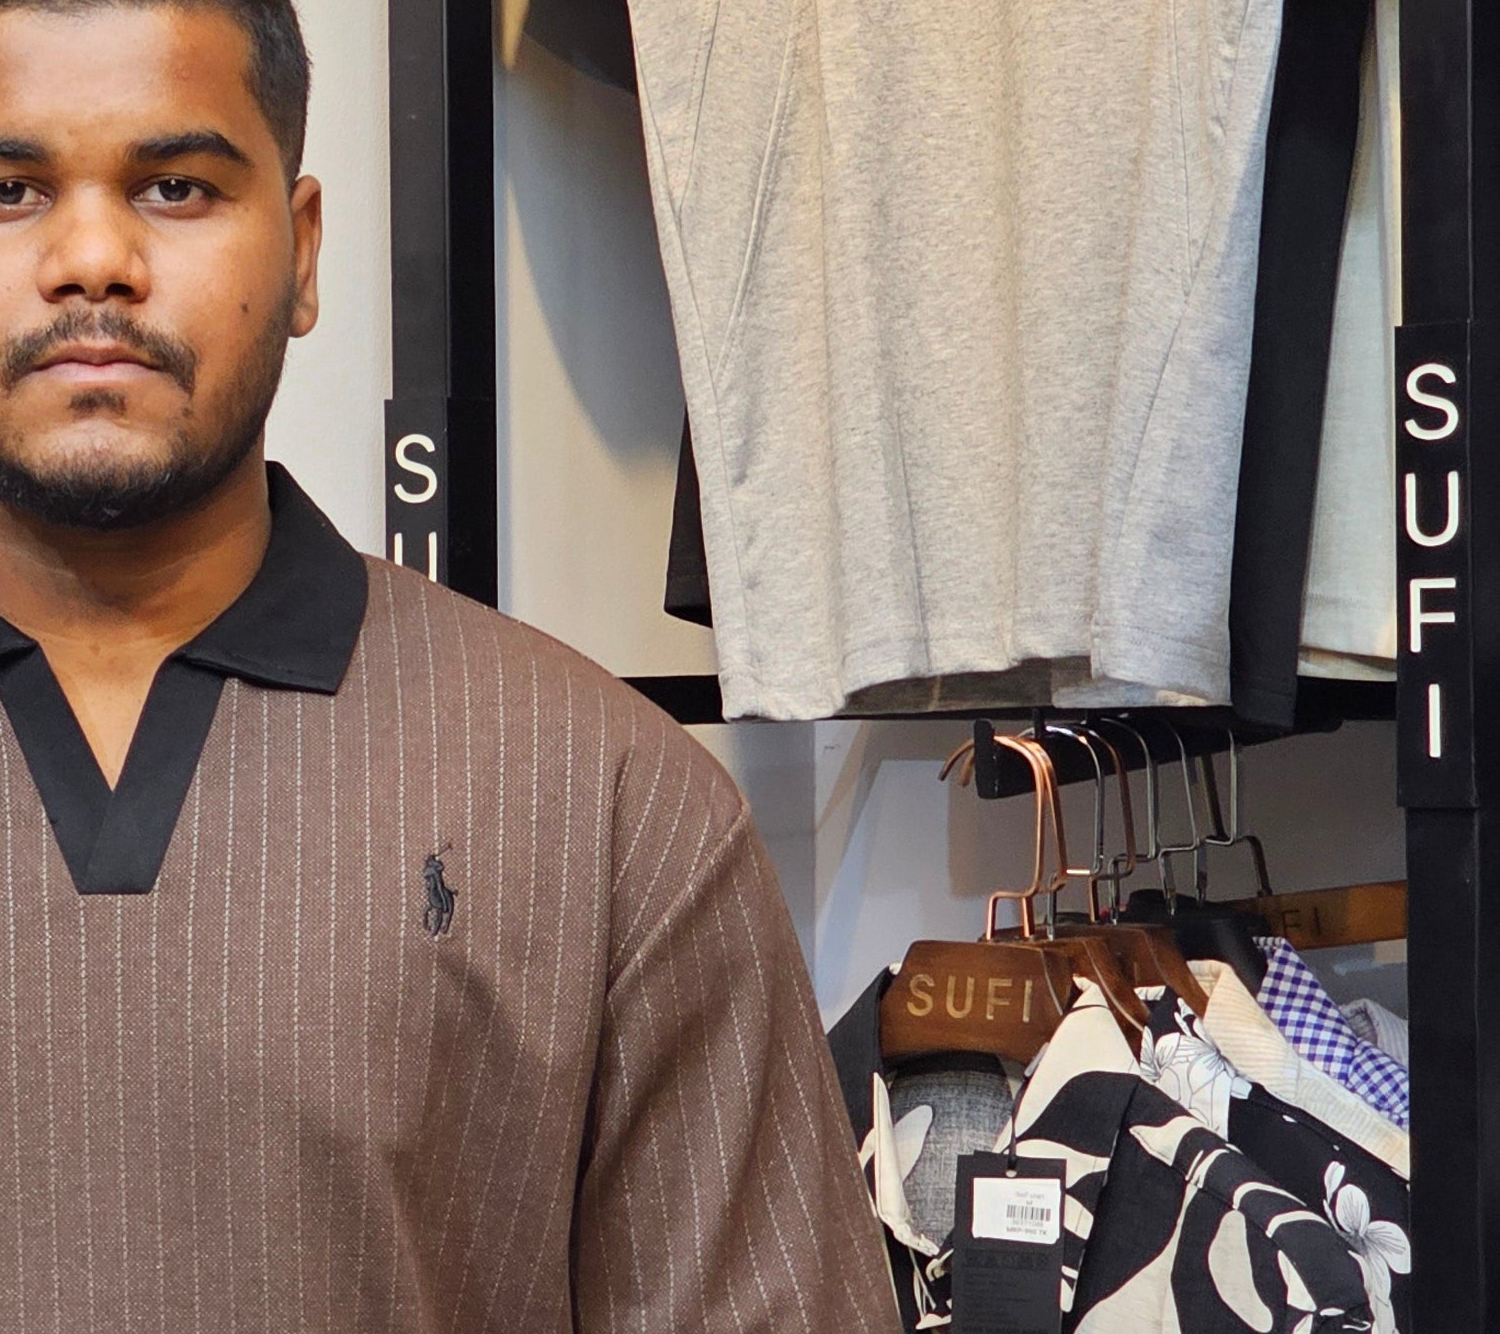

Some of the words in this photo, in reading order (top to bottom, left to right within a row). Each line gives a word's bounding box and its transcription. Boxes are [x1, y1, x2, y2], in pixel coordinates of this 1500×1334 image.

[393, 432, 439, 583] SU
[1403, 362, 1461, 759] SUFI
[906, 973, 1033, 1024] SUFI
